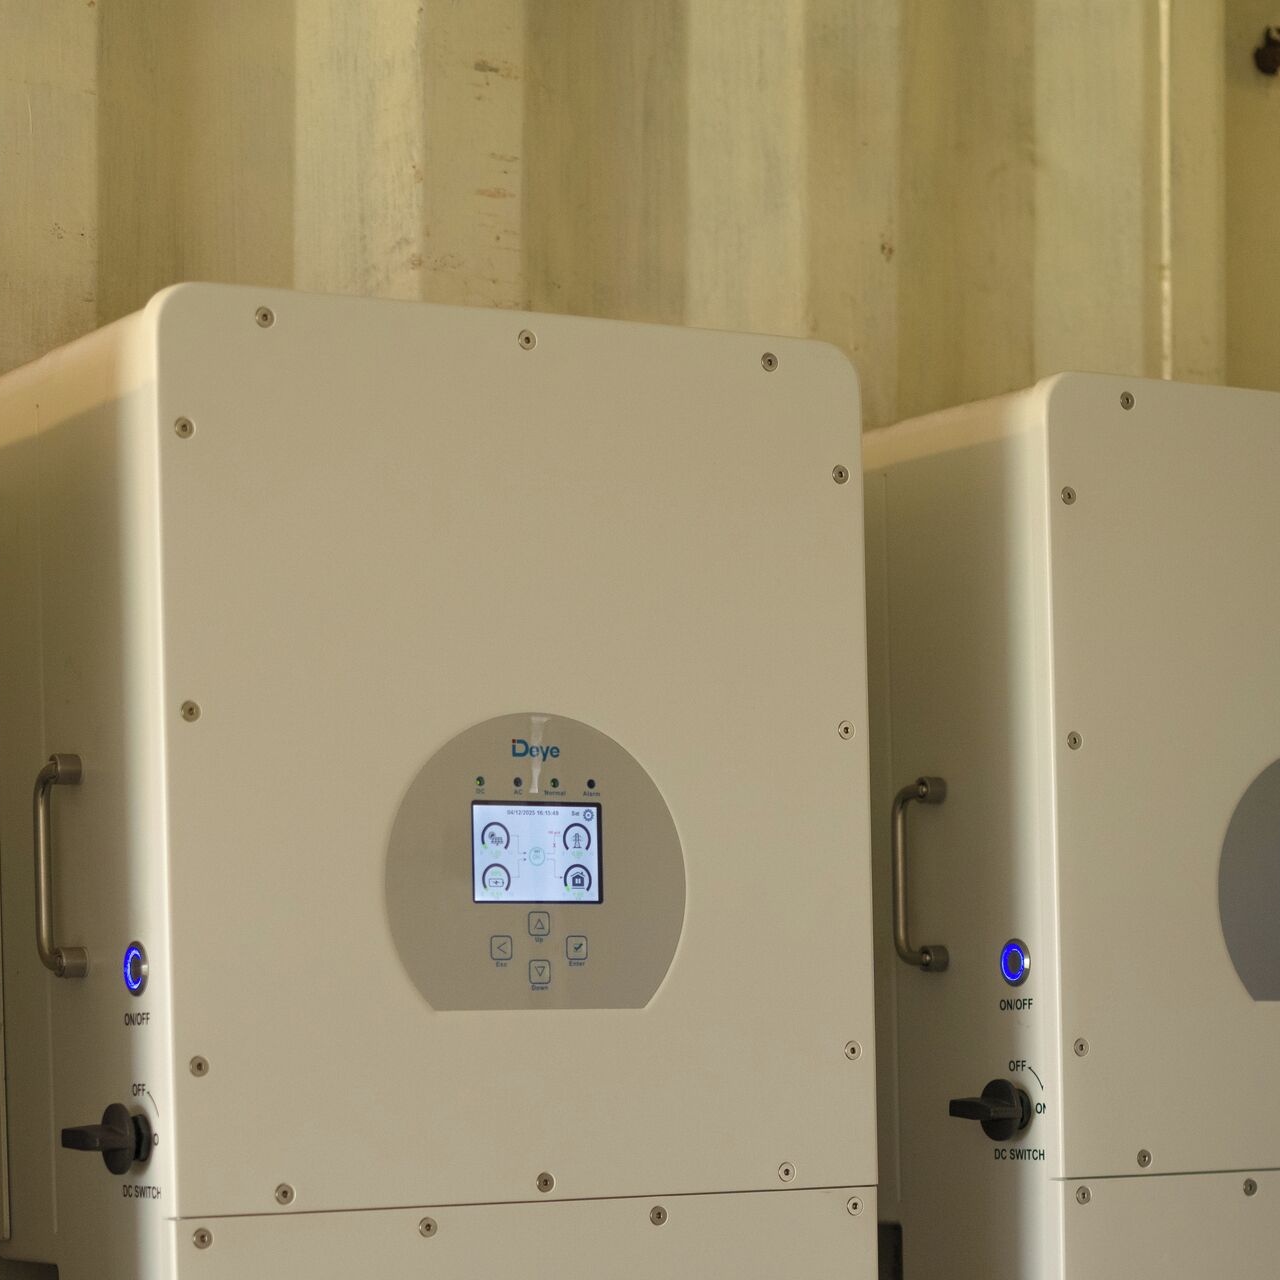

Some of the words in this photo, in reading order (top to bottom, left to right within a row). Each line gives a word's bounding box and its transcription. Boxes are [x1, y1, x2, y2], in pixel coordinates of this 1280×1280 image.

[511, 738, 560, 762] Deye
[999, 998, 1034, 1011] ON/OFF
[124, 1012, 150, 1026] ON/OFF
[1008, 1060, 1027, 1072] OFF
[132, 1084, 146, 1097] OFF
[994, 1148, 1007, 1161] DC
[1009, 1148, 1045, 1161] SWITCH
[122, 1184, 132, 1199] DC
[134, 1184, 162, 1200] SWITCH
